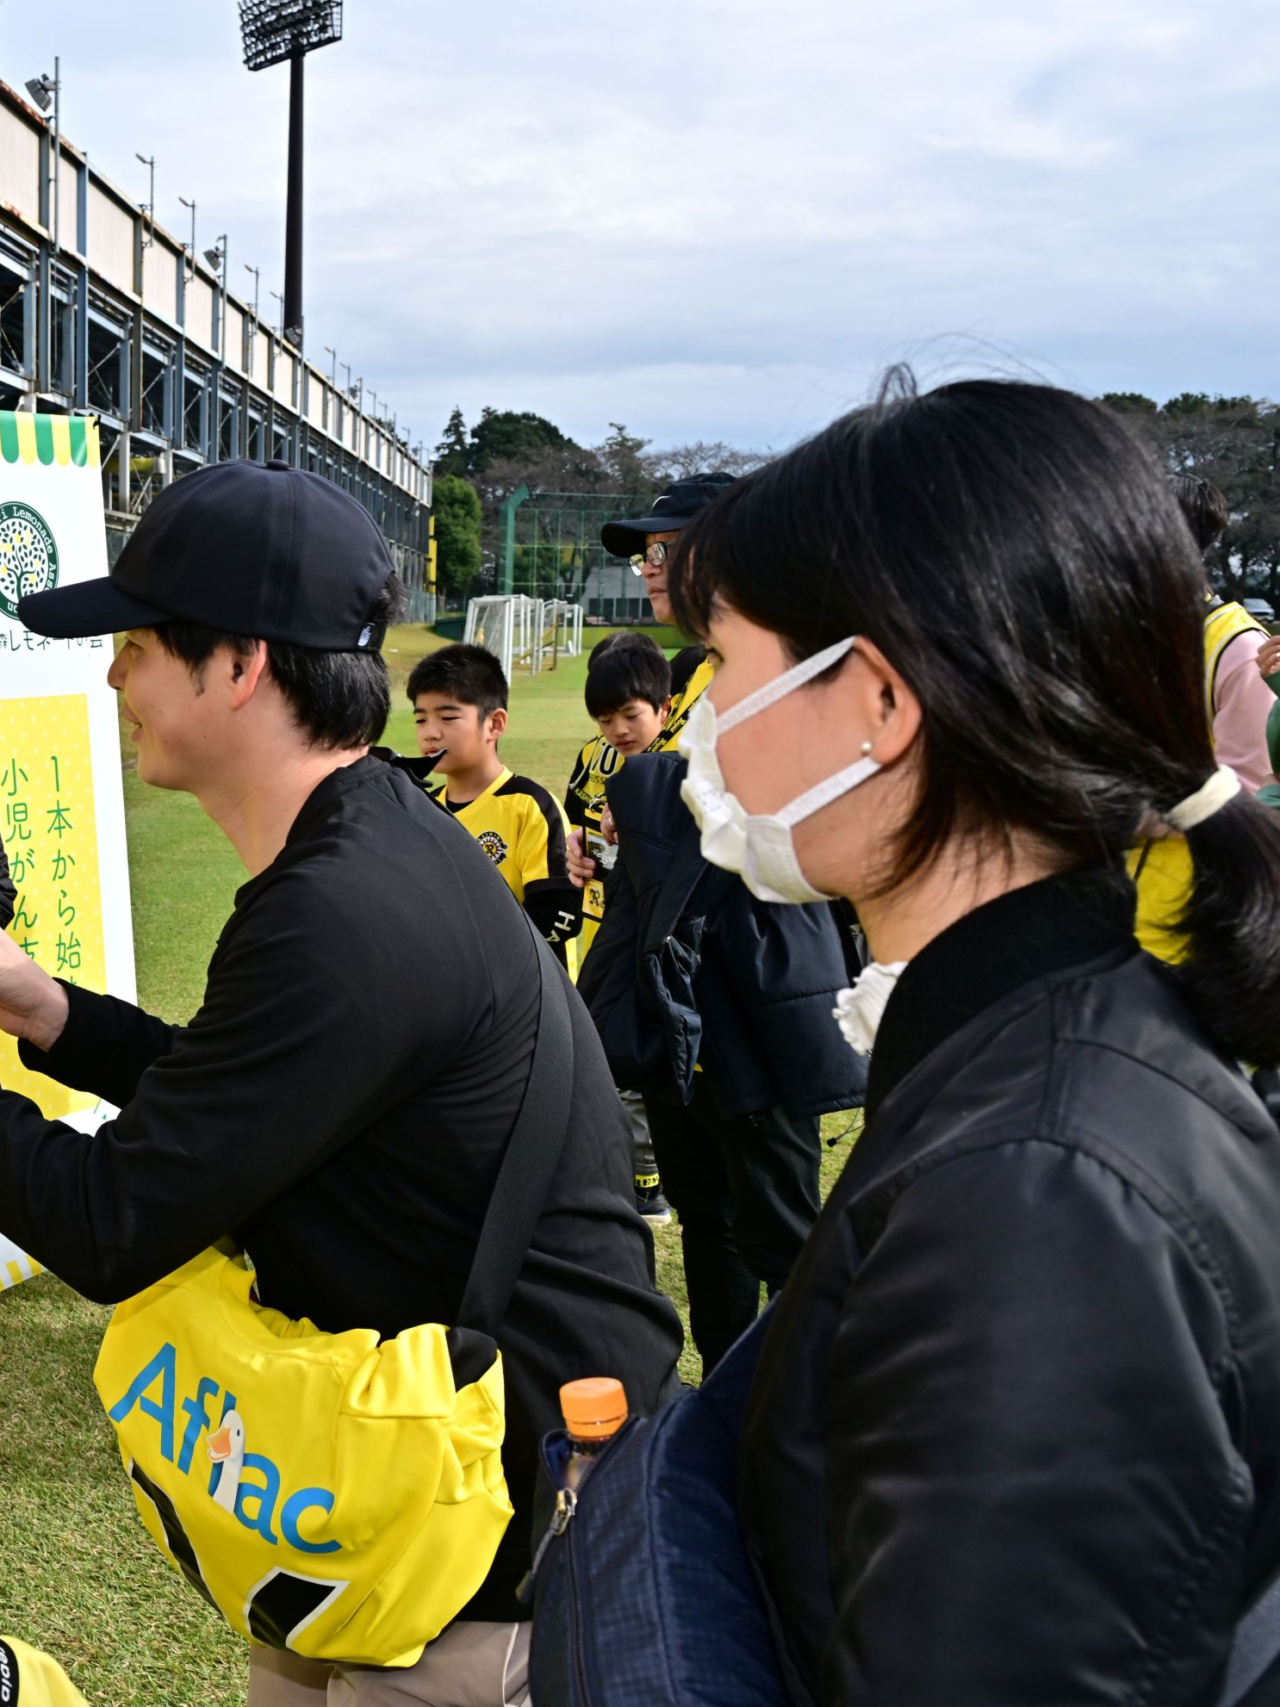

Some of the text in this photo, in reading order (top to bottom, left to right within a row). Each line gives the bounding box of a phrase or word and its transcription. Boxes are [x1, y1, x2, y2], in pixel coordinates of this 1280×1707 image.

[12, 505, 54, 555] Lemonade
[46, 755, 82, 986] 1本から始
[108, 1341, 344, 1555] Aflac
